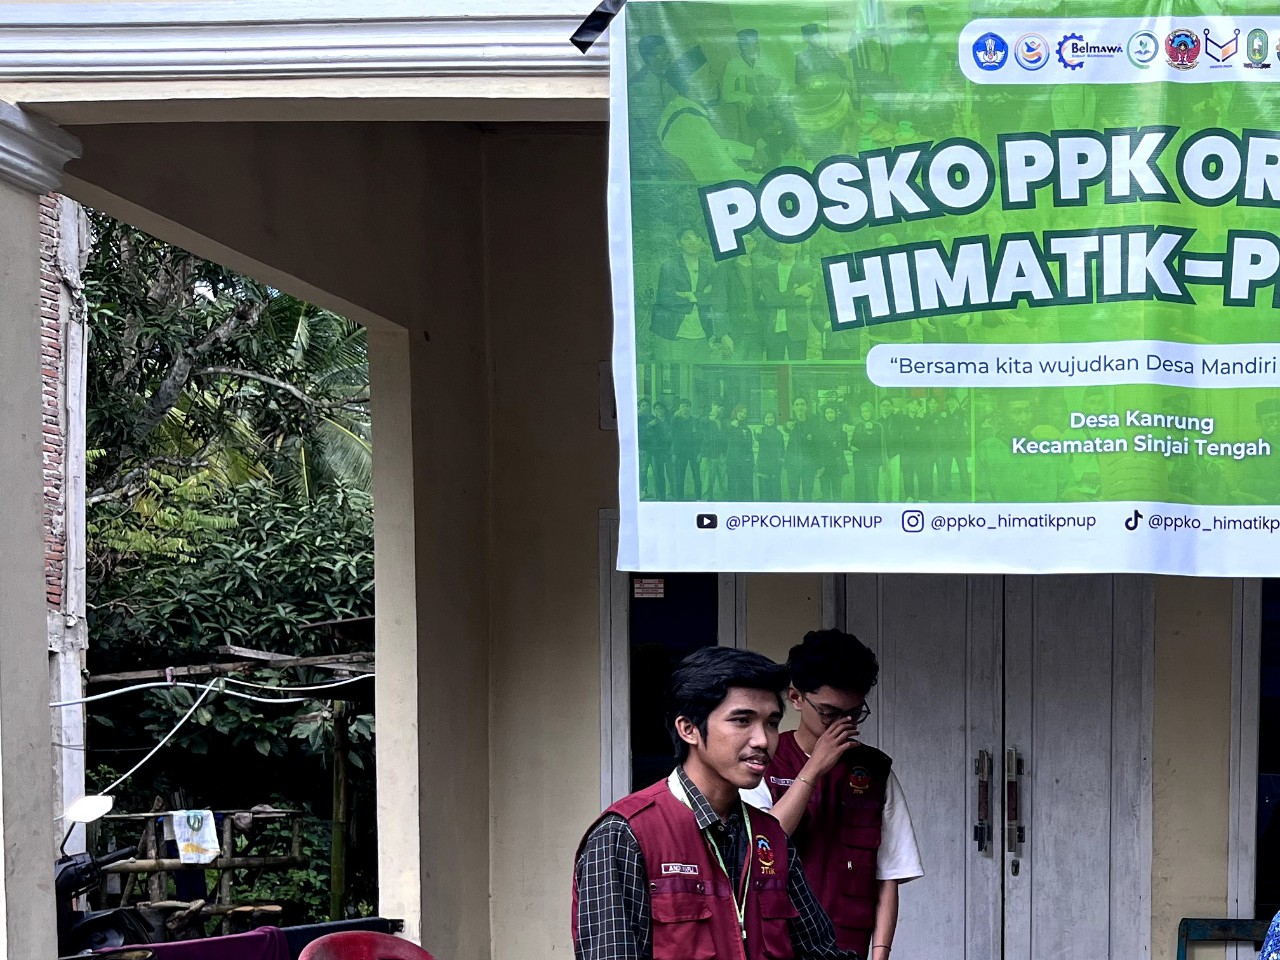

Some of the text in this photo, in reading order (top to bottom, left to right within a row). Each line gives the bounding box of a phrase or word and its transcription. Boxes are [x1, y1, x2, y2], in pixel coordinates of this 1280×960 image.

[1071, 41, 1124, 54] Belmawa
[704, 143, 991, 255] POSKO
[1003, 131, 1168, 204] PPK
[995, 356, 1034, 375] kita
[1037, 354, 1140, 378] wujudkan
[1146, 354, 1195, 375] Desa
[1201, 356, 1277, 376] Mandiri
[1069, 410, 1215, 435] Desa Kanrung
[1011, 433, 1272, 460] Kecamatan Sinjai Tengah
[724, 513, 884, 532] @PPKOHIMATIKPNUP
[930, 513, 1098, 534] @ppko_himatikpnup
